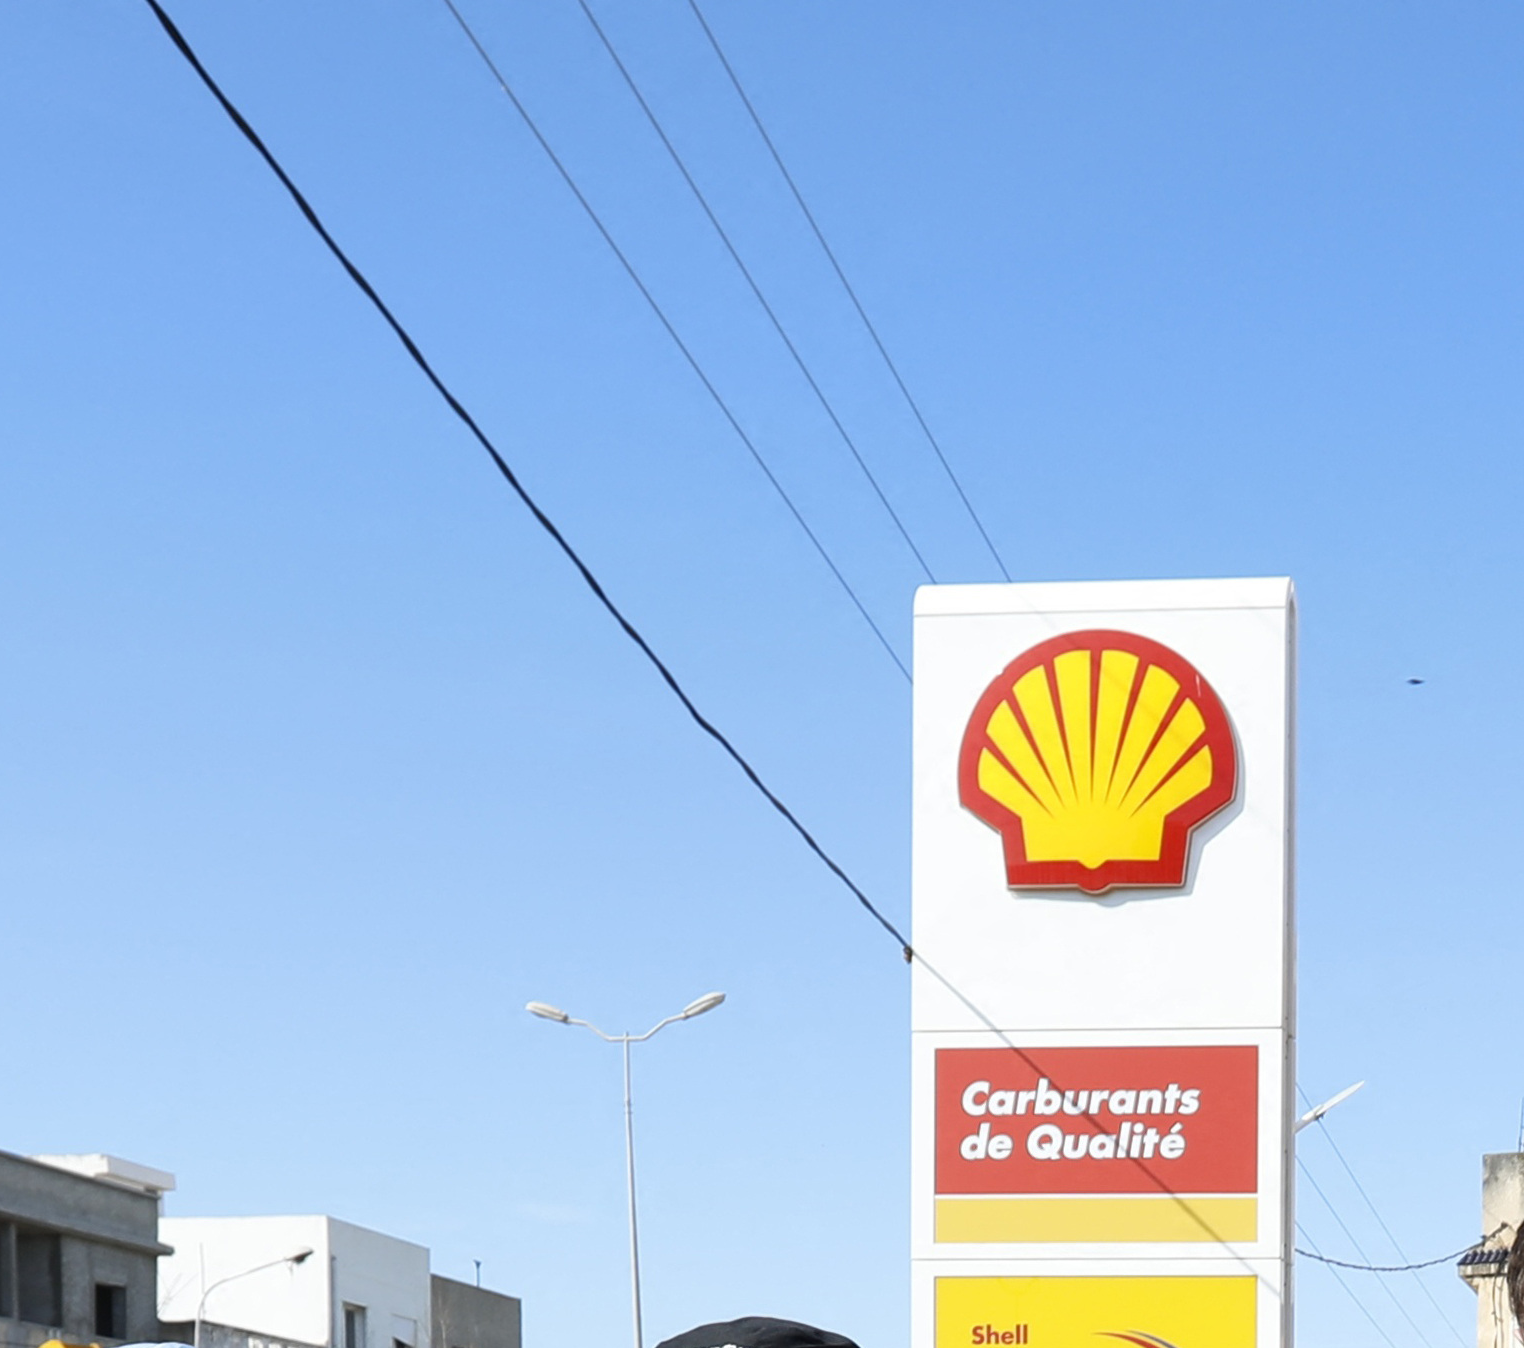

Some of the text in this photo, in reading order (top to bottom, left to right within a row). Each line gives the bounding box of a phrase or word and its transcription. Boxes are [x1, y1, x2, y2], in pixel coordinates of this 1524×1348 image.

[961, 1077, 1201, 1116] Carburants
[959, 1121, 1186, 1161] de Qualité
[972, 1324, 1028, 1345] Shell
